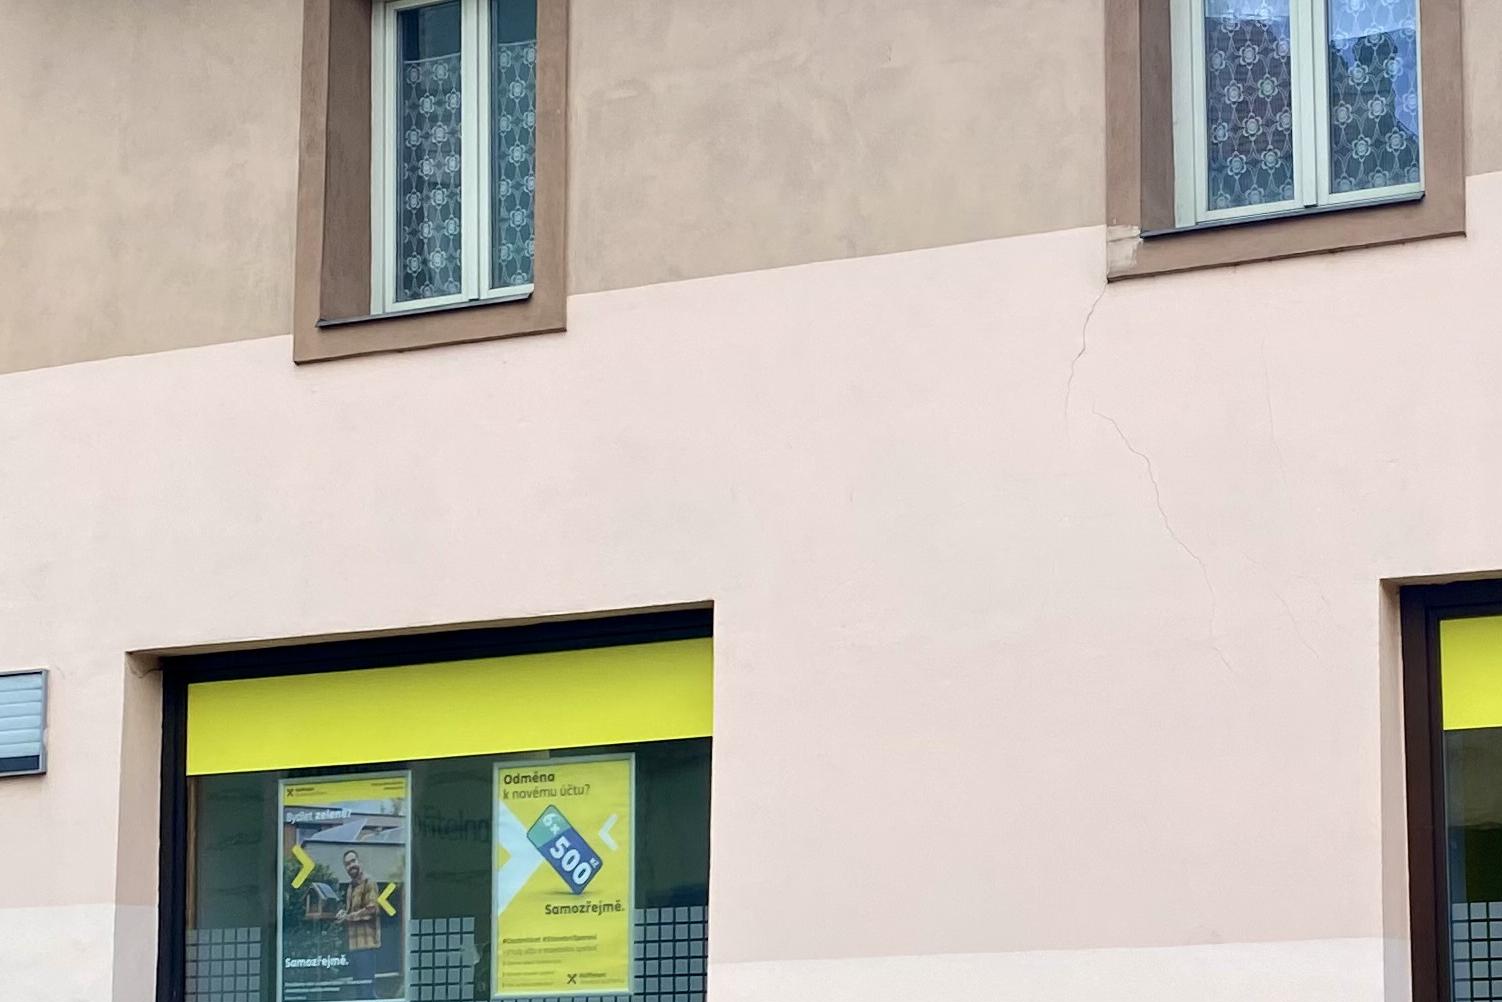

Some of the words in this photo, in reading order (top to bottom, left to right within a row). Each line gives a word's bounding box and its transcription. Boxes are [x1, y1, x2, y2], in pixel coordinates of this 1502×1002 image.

[503, 771, 556, 785] Odměna
[511, 786, 558, 800] novému
[559, 783, 591, 797] účtu?
[549, 835, 593, 885] 500
[544, 899, 626, 916] Samozřejmě.
